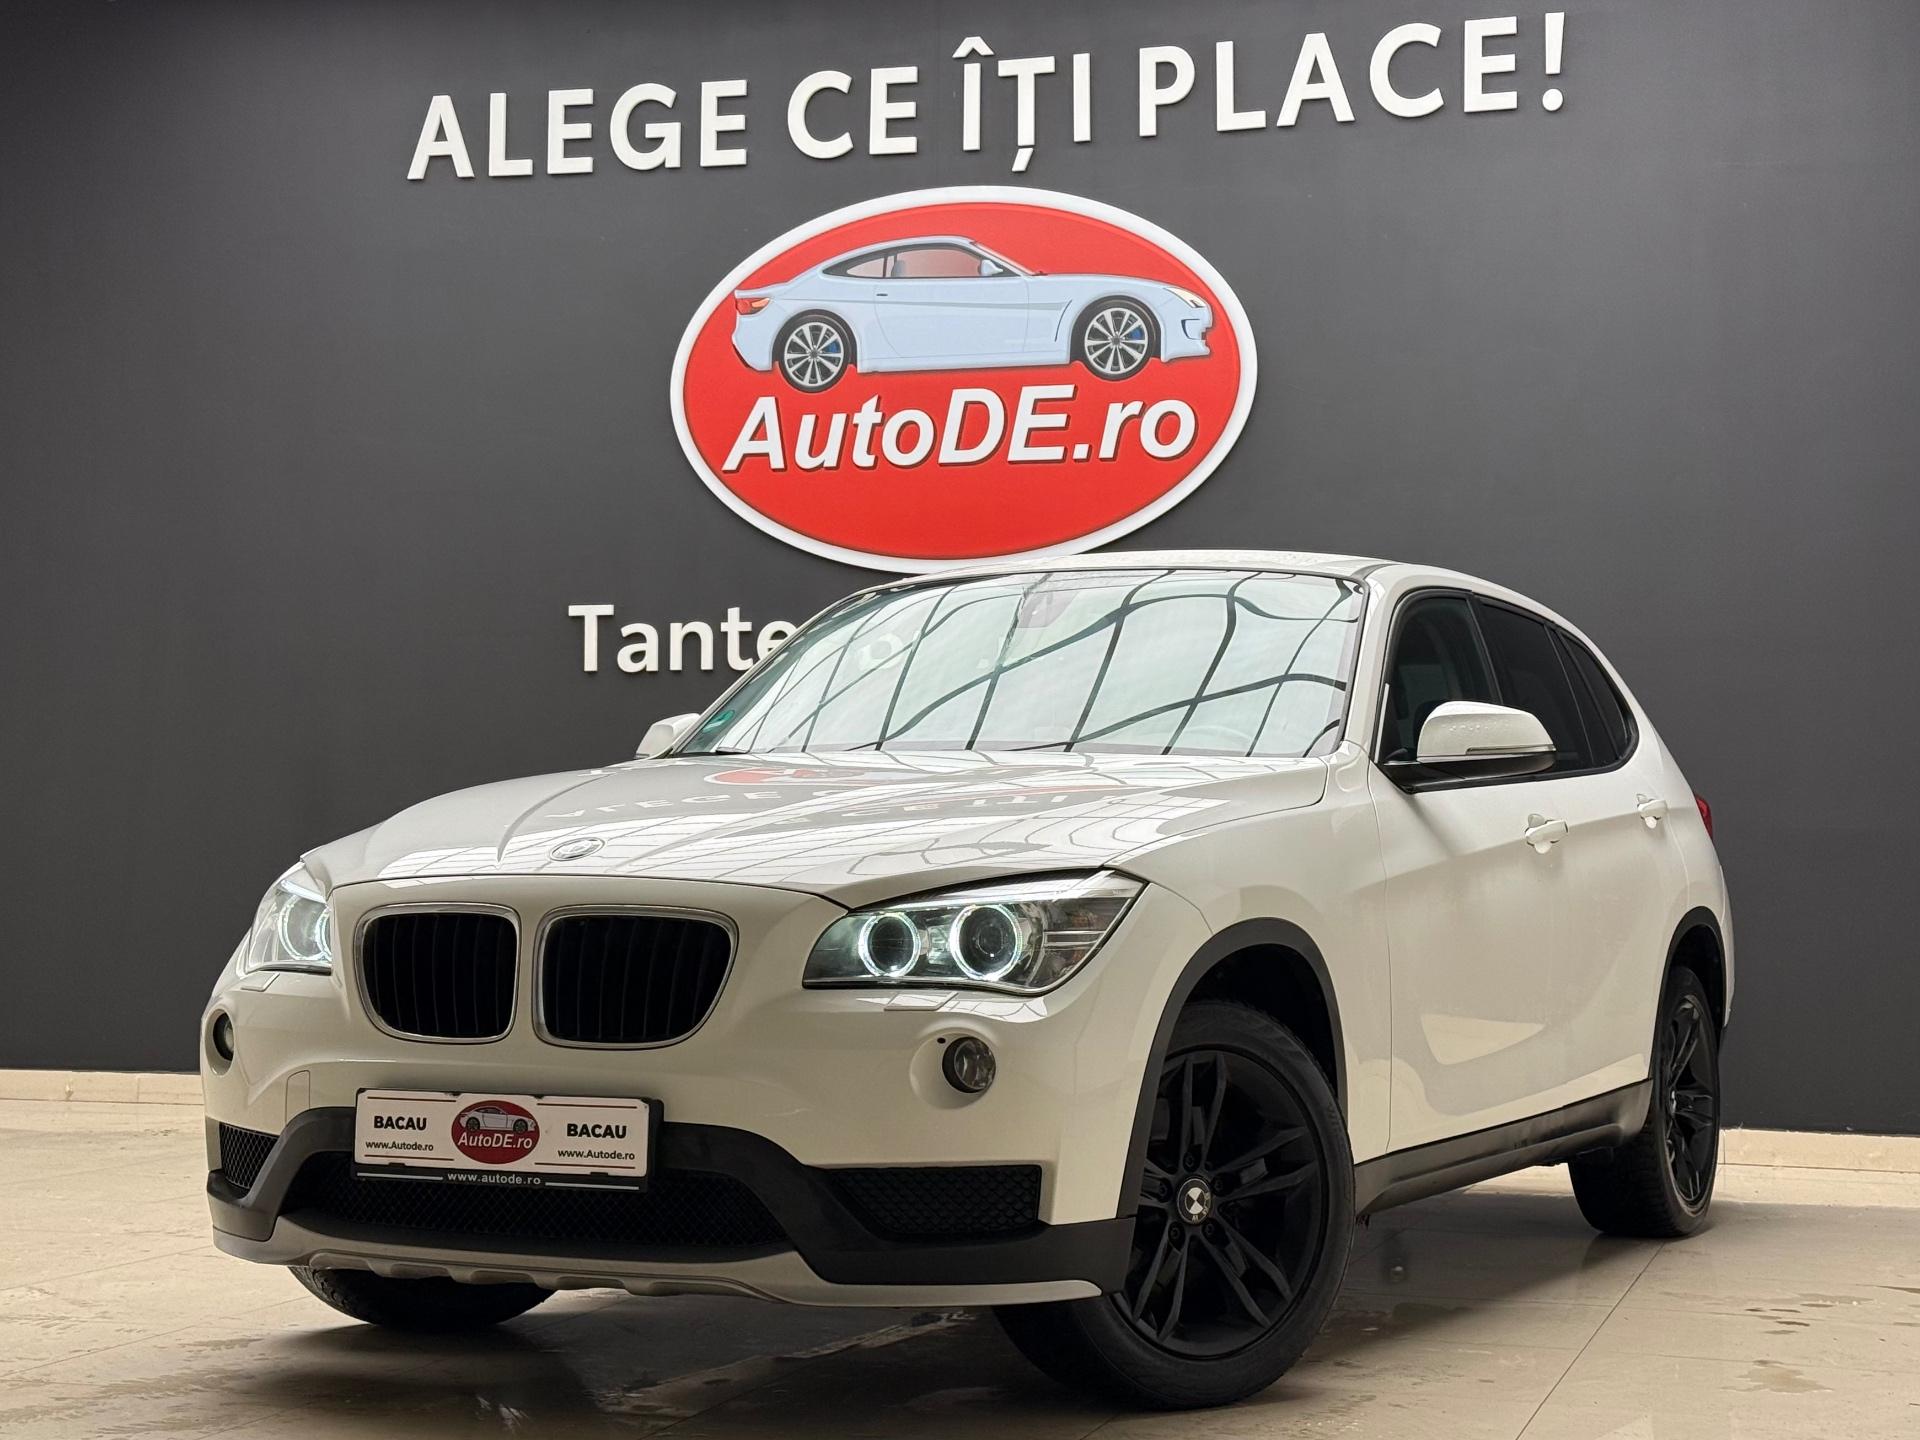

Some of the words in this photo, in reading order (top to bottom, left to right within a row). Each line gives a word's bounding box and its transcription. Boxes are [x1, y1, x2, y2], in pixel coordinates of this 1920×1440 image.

[406, 79, 748, 180] ALEGE
[787, 66, 918, 158] CE
[952, 36, 1091, 171] ÎȚI
[1139, 12, 1565, 137] PLACE!
[721, 384, 1197, 473] AutoDE.ro
[373, 1116, 428, 1131] BACAU
[566, 1123, 628, 1139] BACAU
[365, 1140, 434, 1151] www.Autode.ro
[457, 1131, 533, 1149] AutoDE.ro
[557, 1149, 636, 1161] www.Autode.ro
[447, 1171, 542, 1186] www.autode.ro
